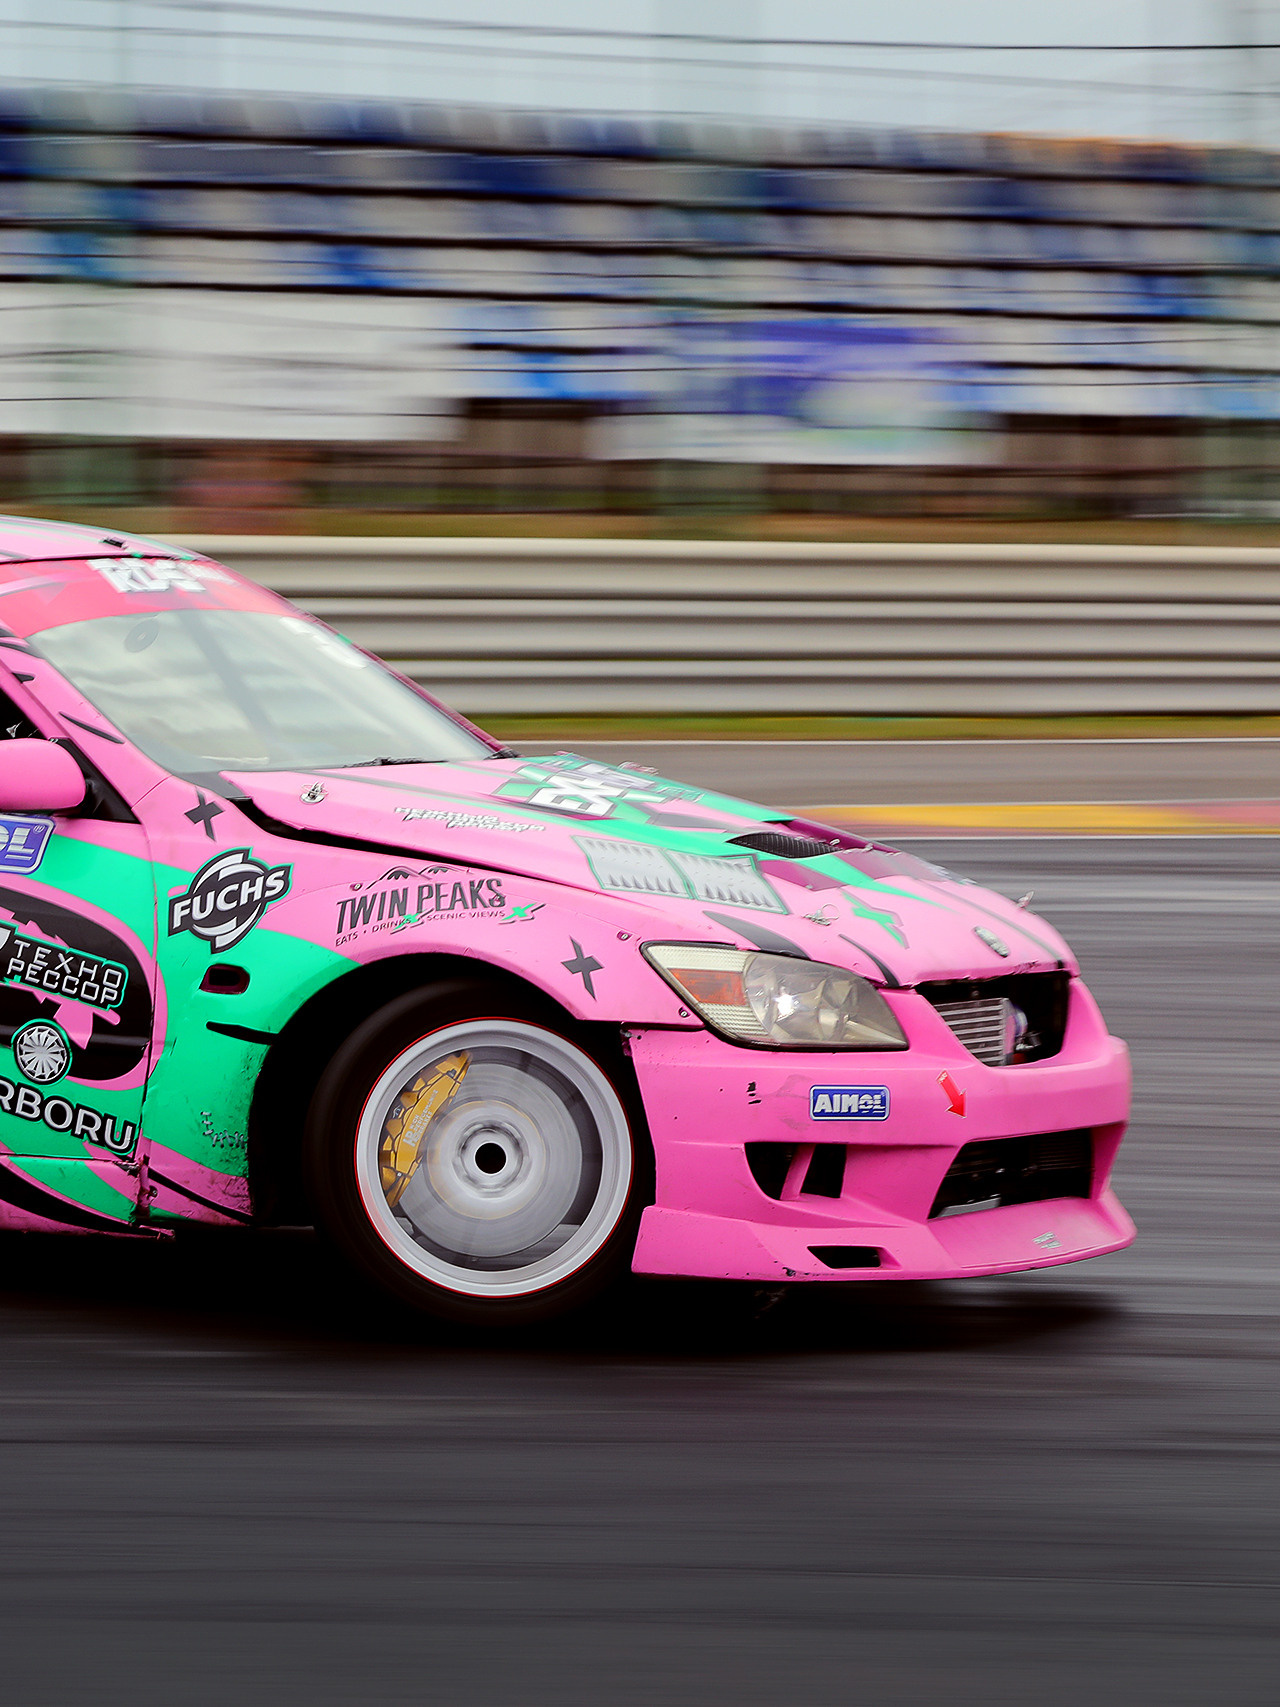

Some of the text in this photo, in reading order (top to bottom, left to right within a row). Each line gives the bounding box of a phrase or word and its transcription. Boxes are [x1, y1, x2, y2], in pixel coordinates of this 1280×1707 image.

[173, 870, 285, 929] FUCHS
[336, 878, 507, 935] TWIN PEAKS
[335, 931, 359, 947] EATS
[426, 911, 467, 922] SCENIC
[468, 909, 507, 919] VIEWS
[813, 1093, 886, 1114] AIMOL
